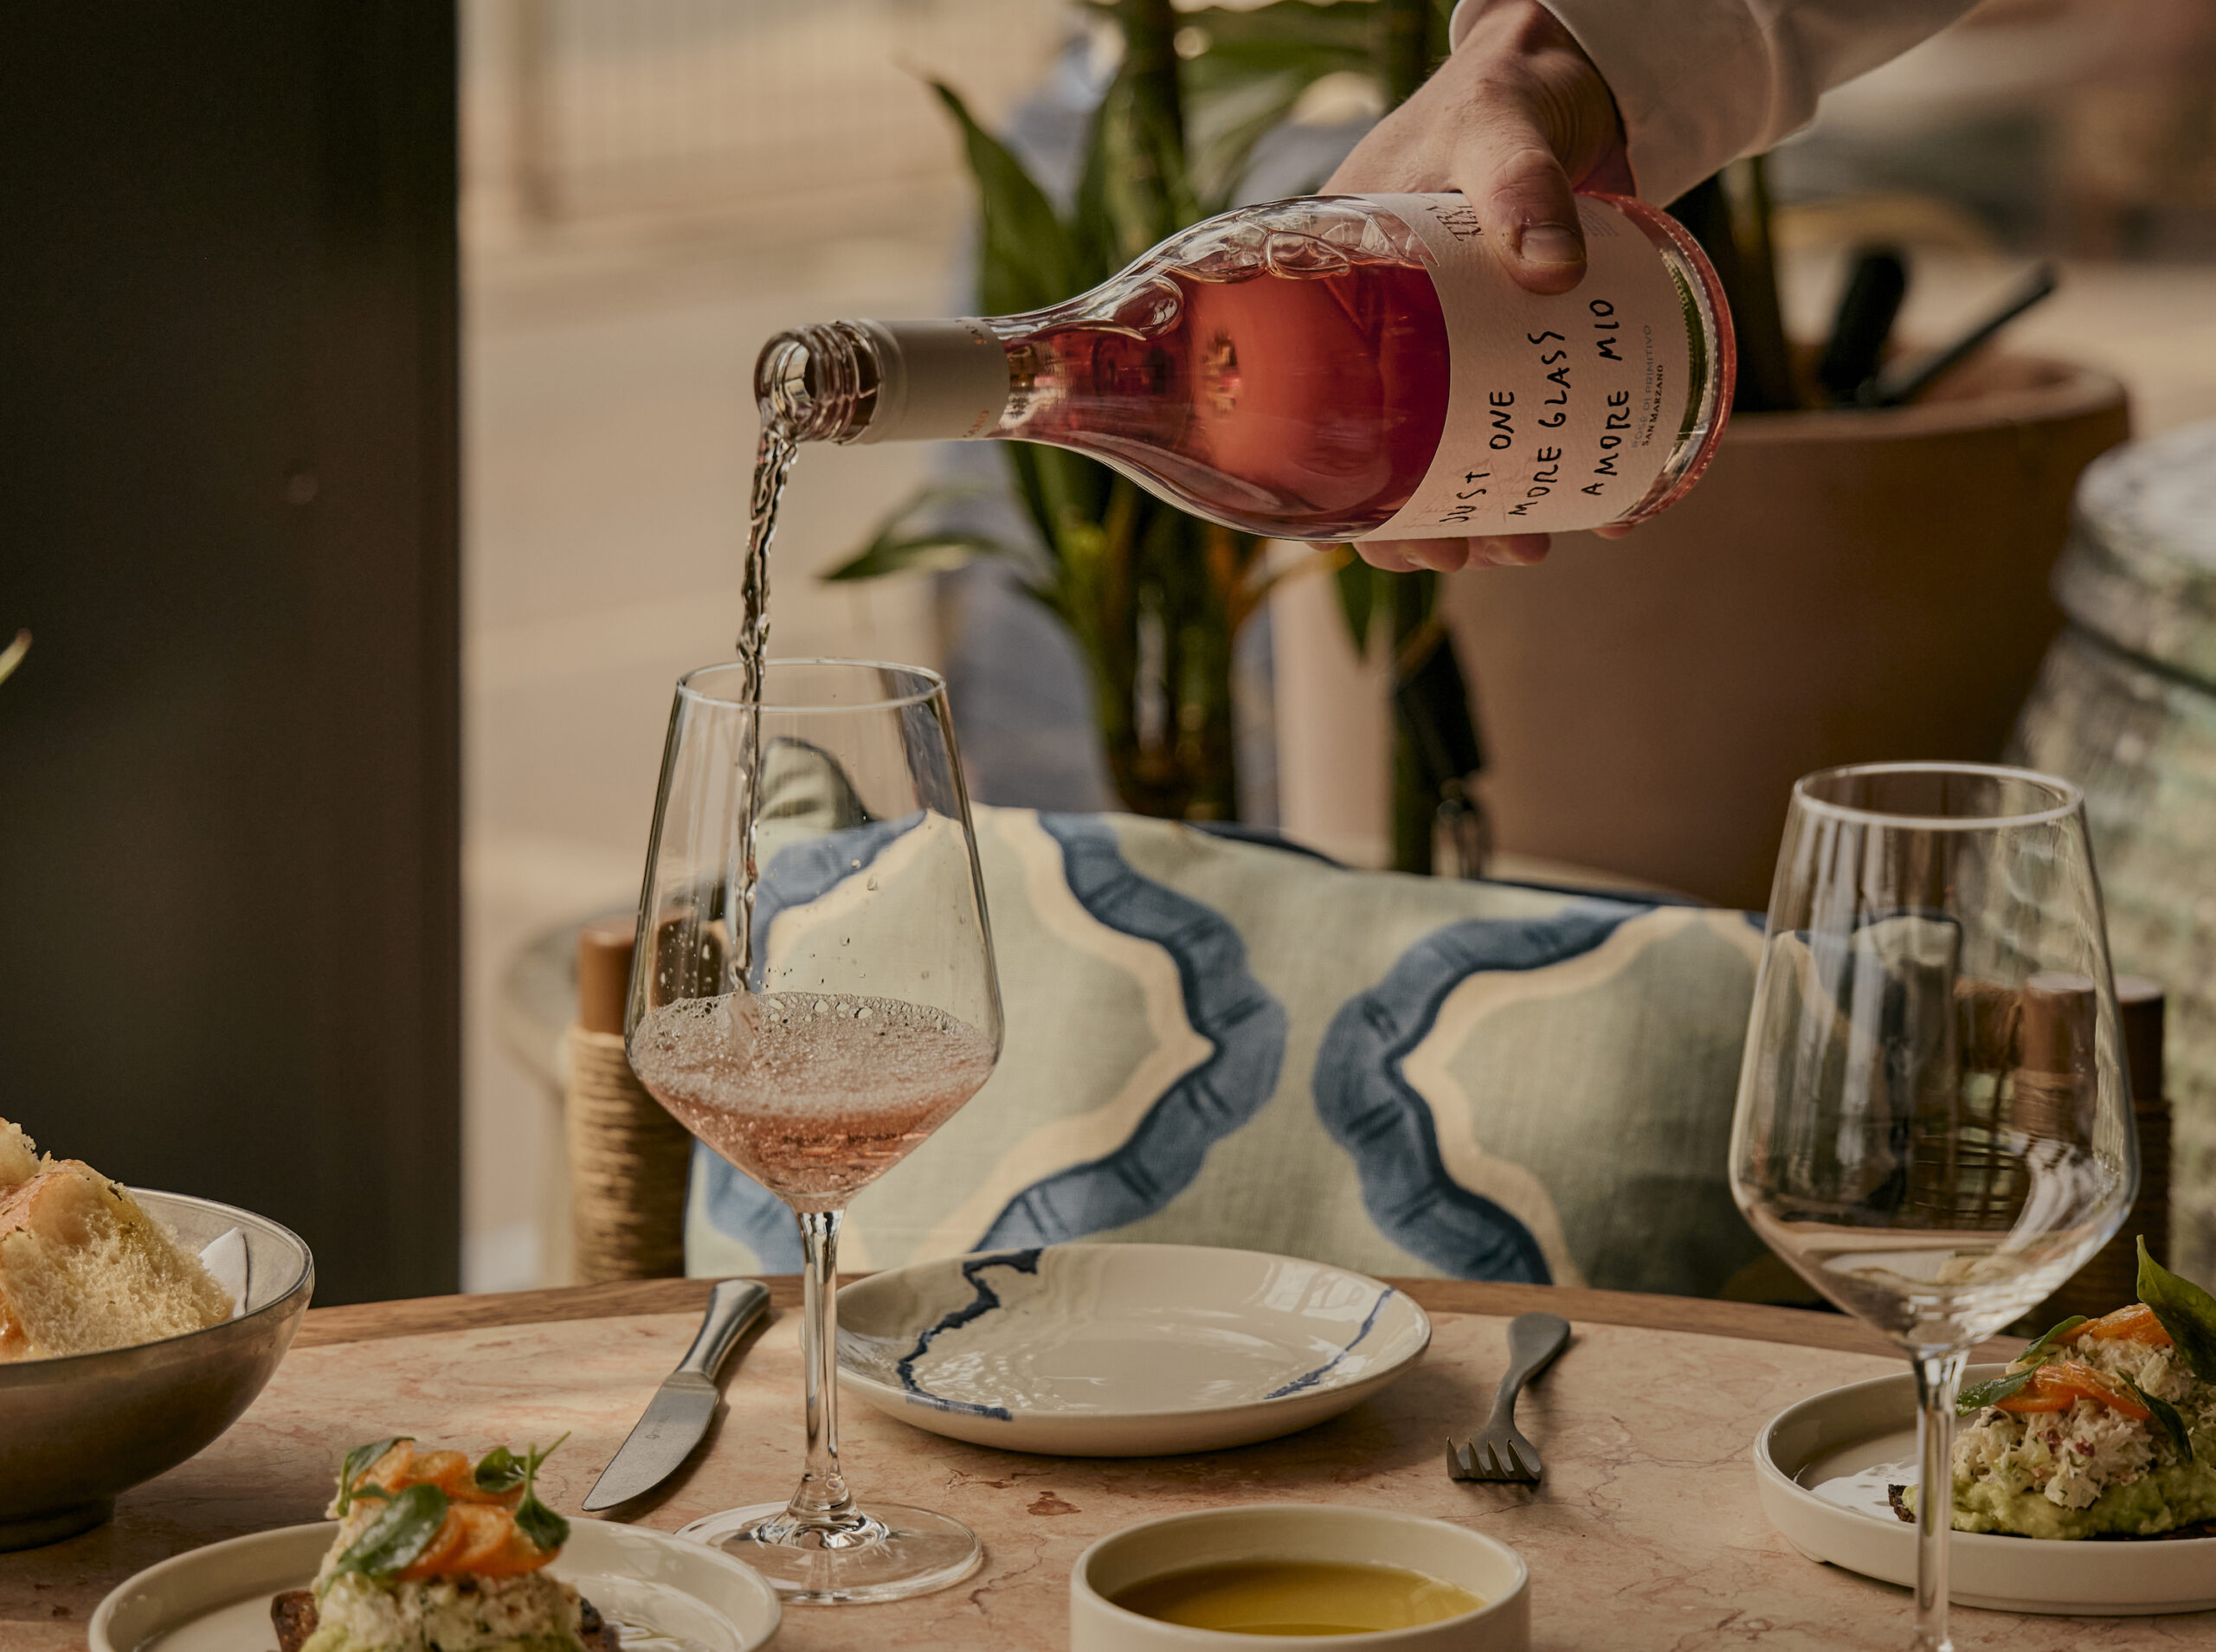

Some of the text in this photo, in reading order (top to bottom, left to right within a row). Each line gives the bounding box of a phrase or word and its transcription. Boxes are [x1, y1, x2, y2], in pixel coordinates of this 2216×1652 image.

[1581, 299, 1632, 496] AMORE MIO
[1641, 364, 1664, 447] SAN MARZANO
[1643, 398, 1652, 411] DI
[1644, 325, 1653, 394] PRIMITIVO
[1439, 391, 1515, 523] JUST ONE
[1508, 331, 1571, 516] MORE GLASS
